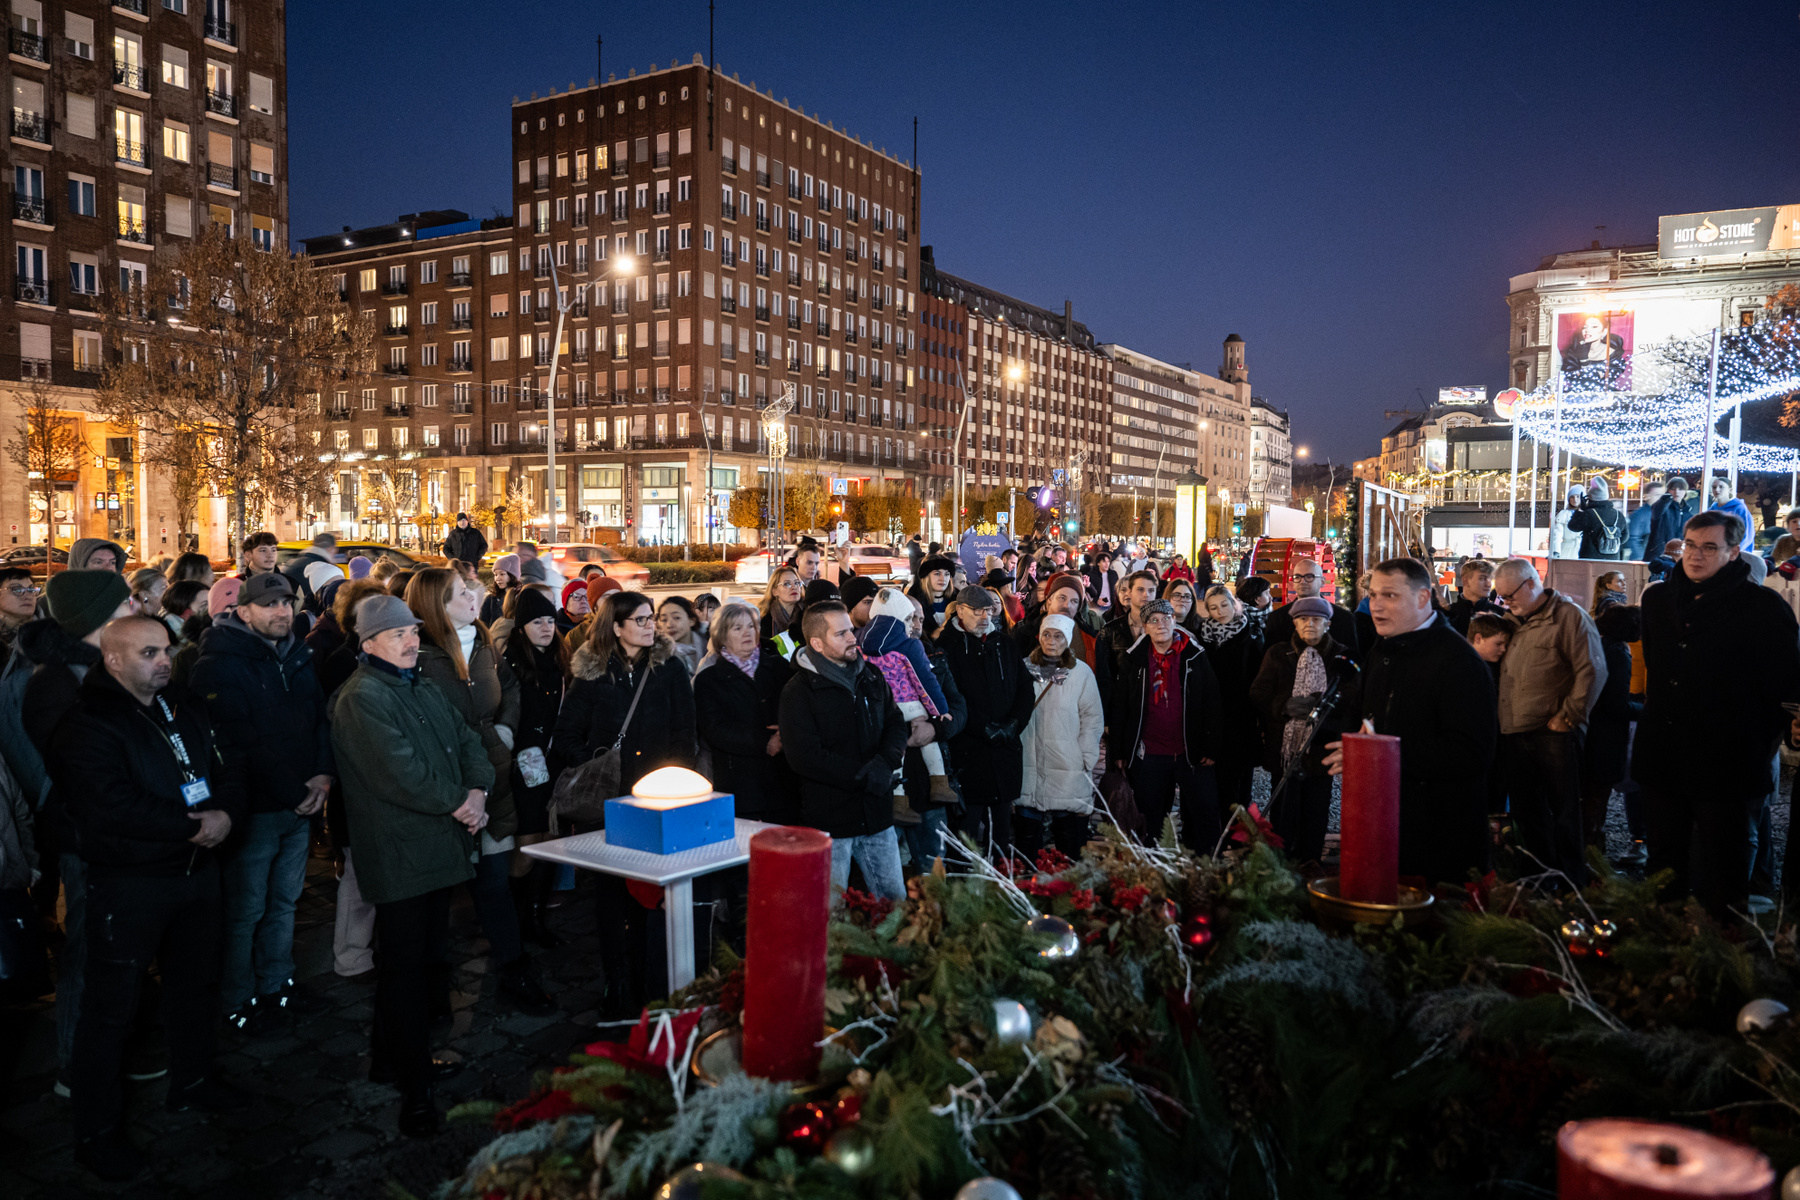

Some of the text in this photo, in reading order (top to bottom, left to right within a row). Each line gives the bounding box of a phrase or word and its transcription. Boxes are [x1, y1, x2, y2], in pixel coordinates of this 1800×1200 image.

[1674, 223, 1755, 243] HOT STONE
[174, 733, 190, 765] SECURITY
